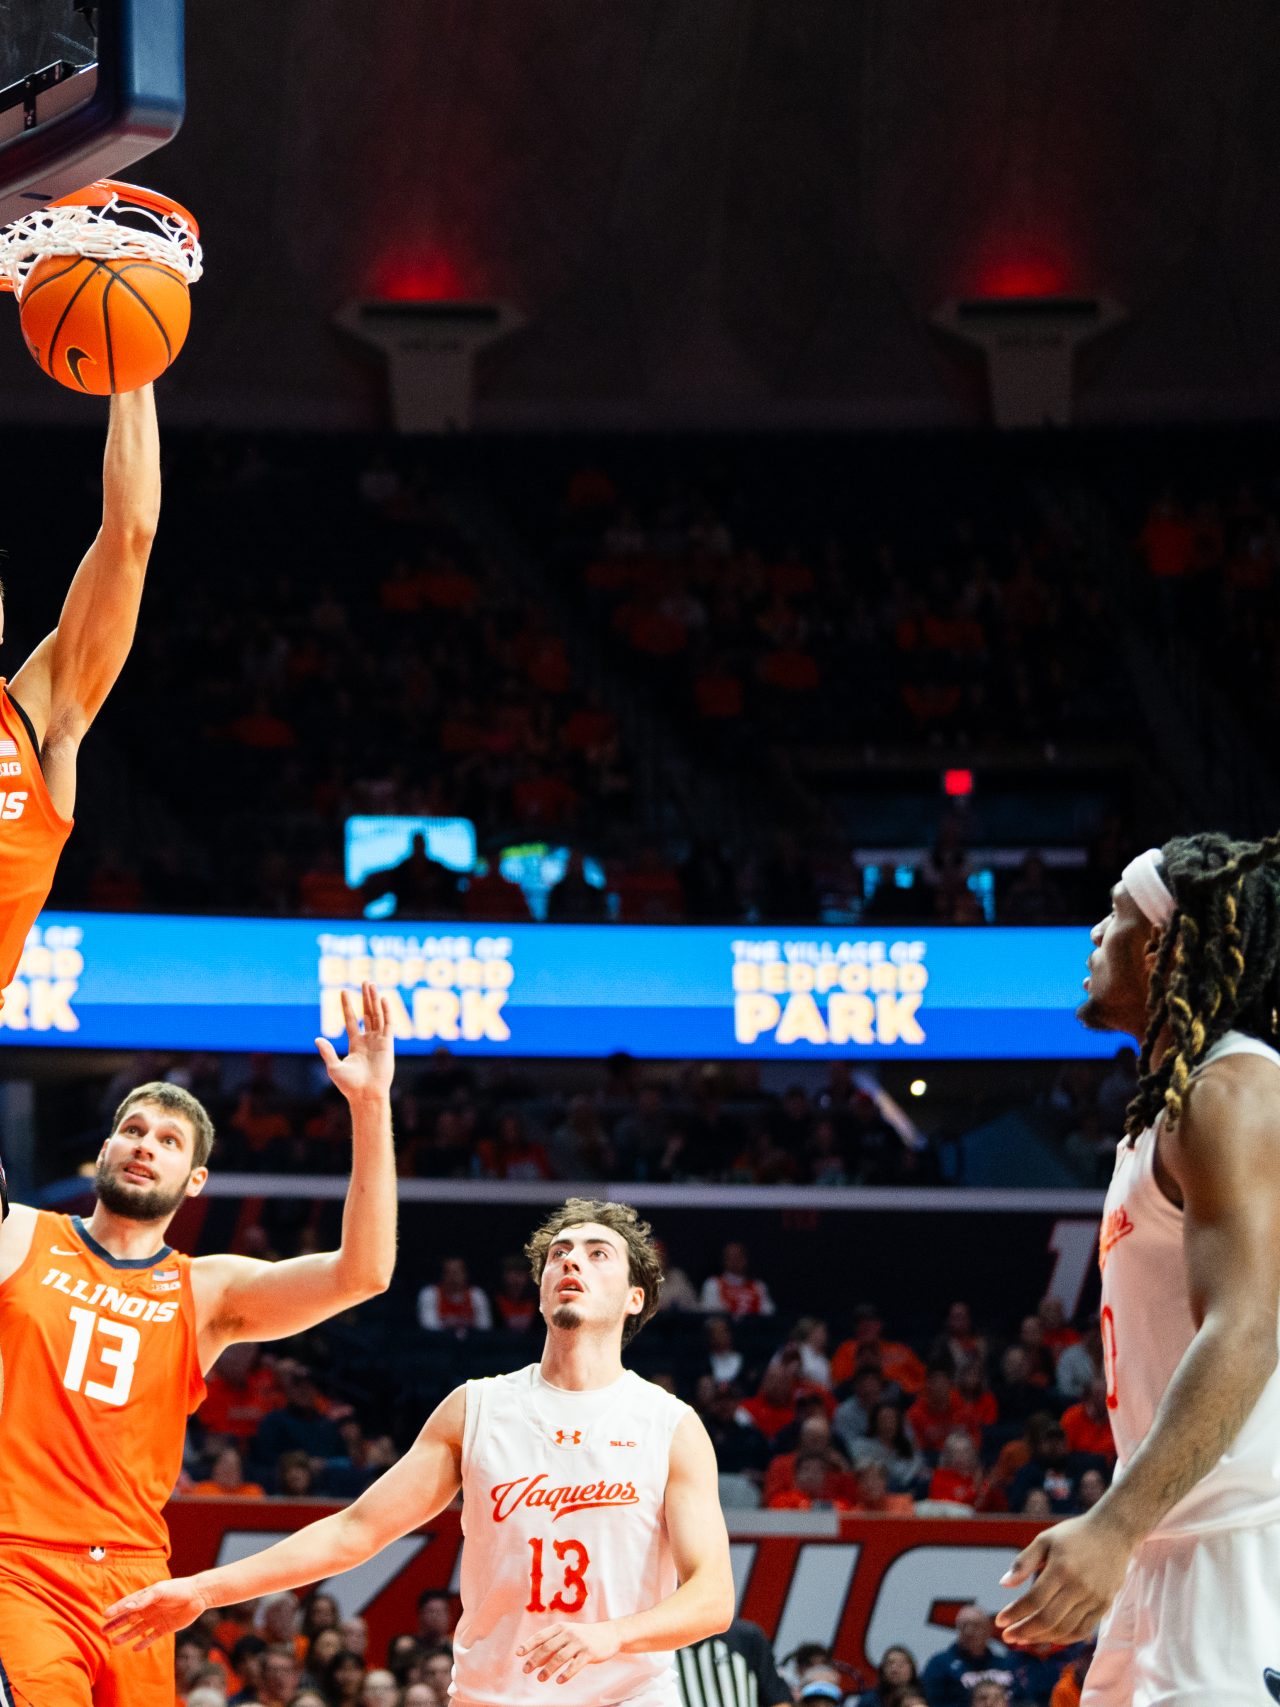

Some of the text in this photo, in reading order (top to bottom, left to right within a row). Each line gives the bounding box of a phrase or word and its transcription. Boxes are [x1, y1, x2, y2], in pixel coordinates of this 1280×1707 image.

[317, 934, 513, 958] THE VILLAGE OF
[731, 940, 927, 963] THE VILLAGE OF
[319, 955, 515, 989] BEDFORD
[732, 961, 929, 994] BEDFORD
[734, 991, 927, 1045] PARK
[41, 1268, 179, 1323] ILLINOIS
[63, 1305, 141, 1406] 13
[491, 1474, 640, 1523] Vaqueros
[525, 1537, 591, 1614] 13
